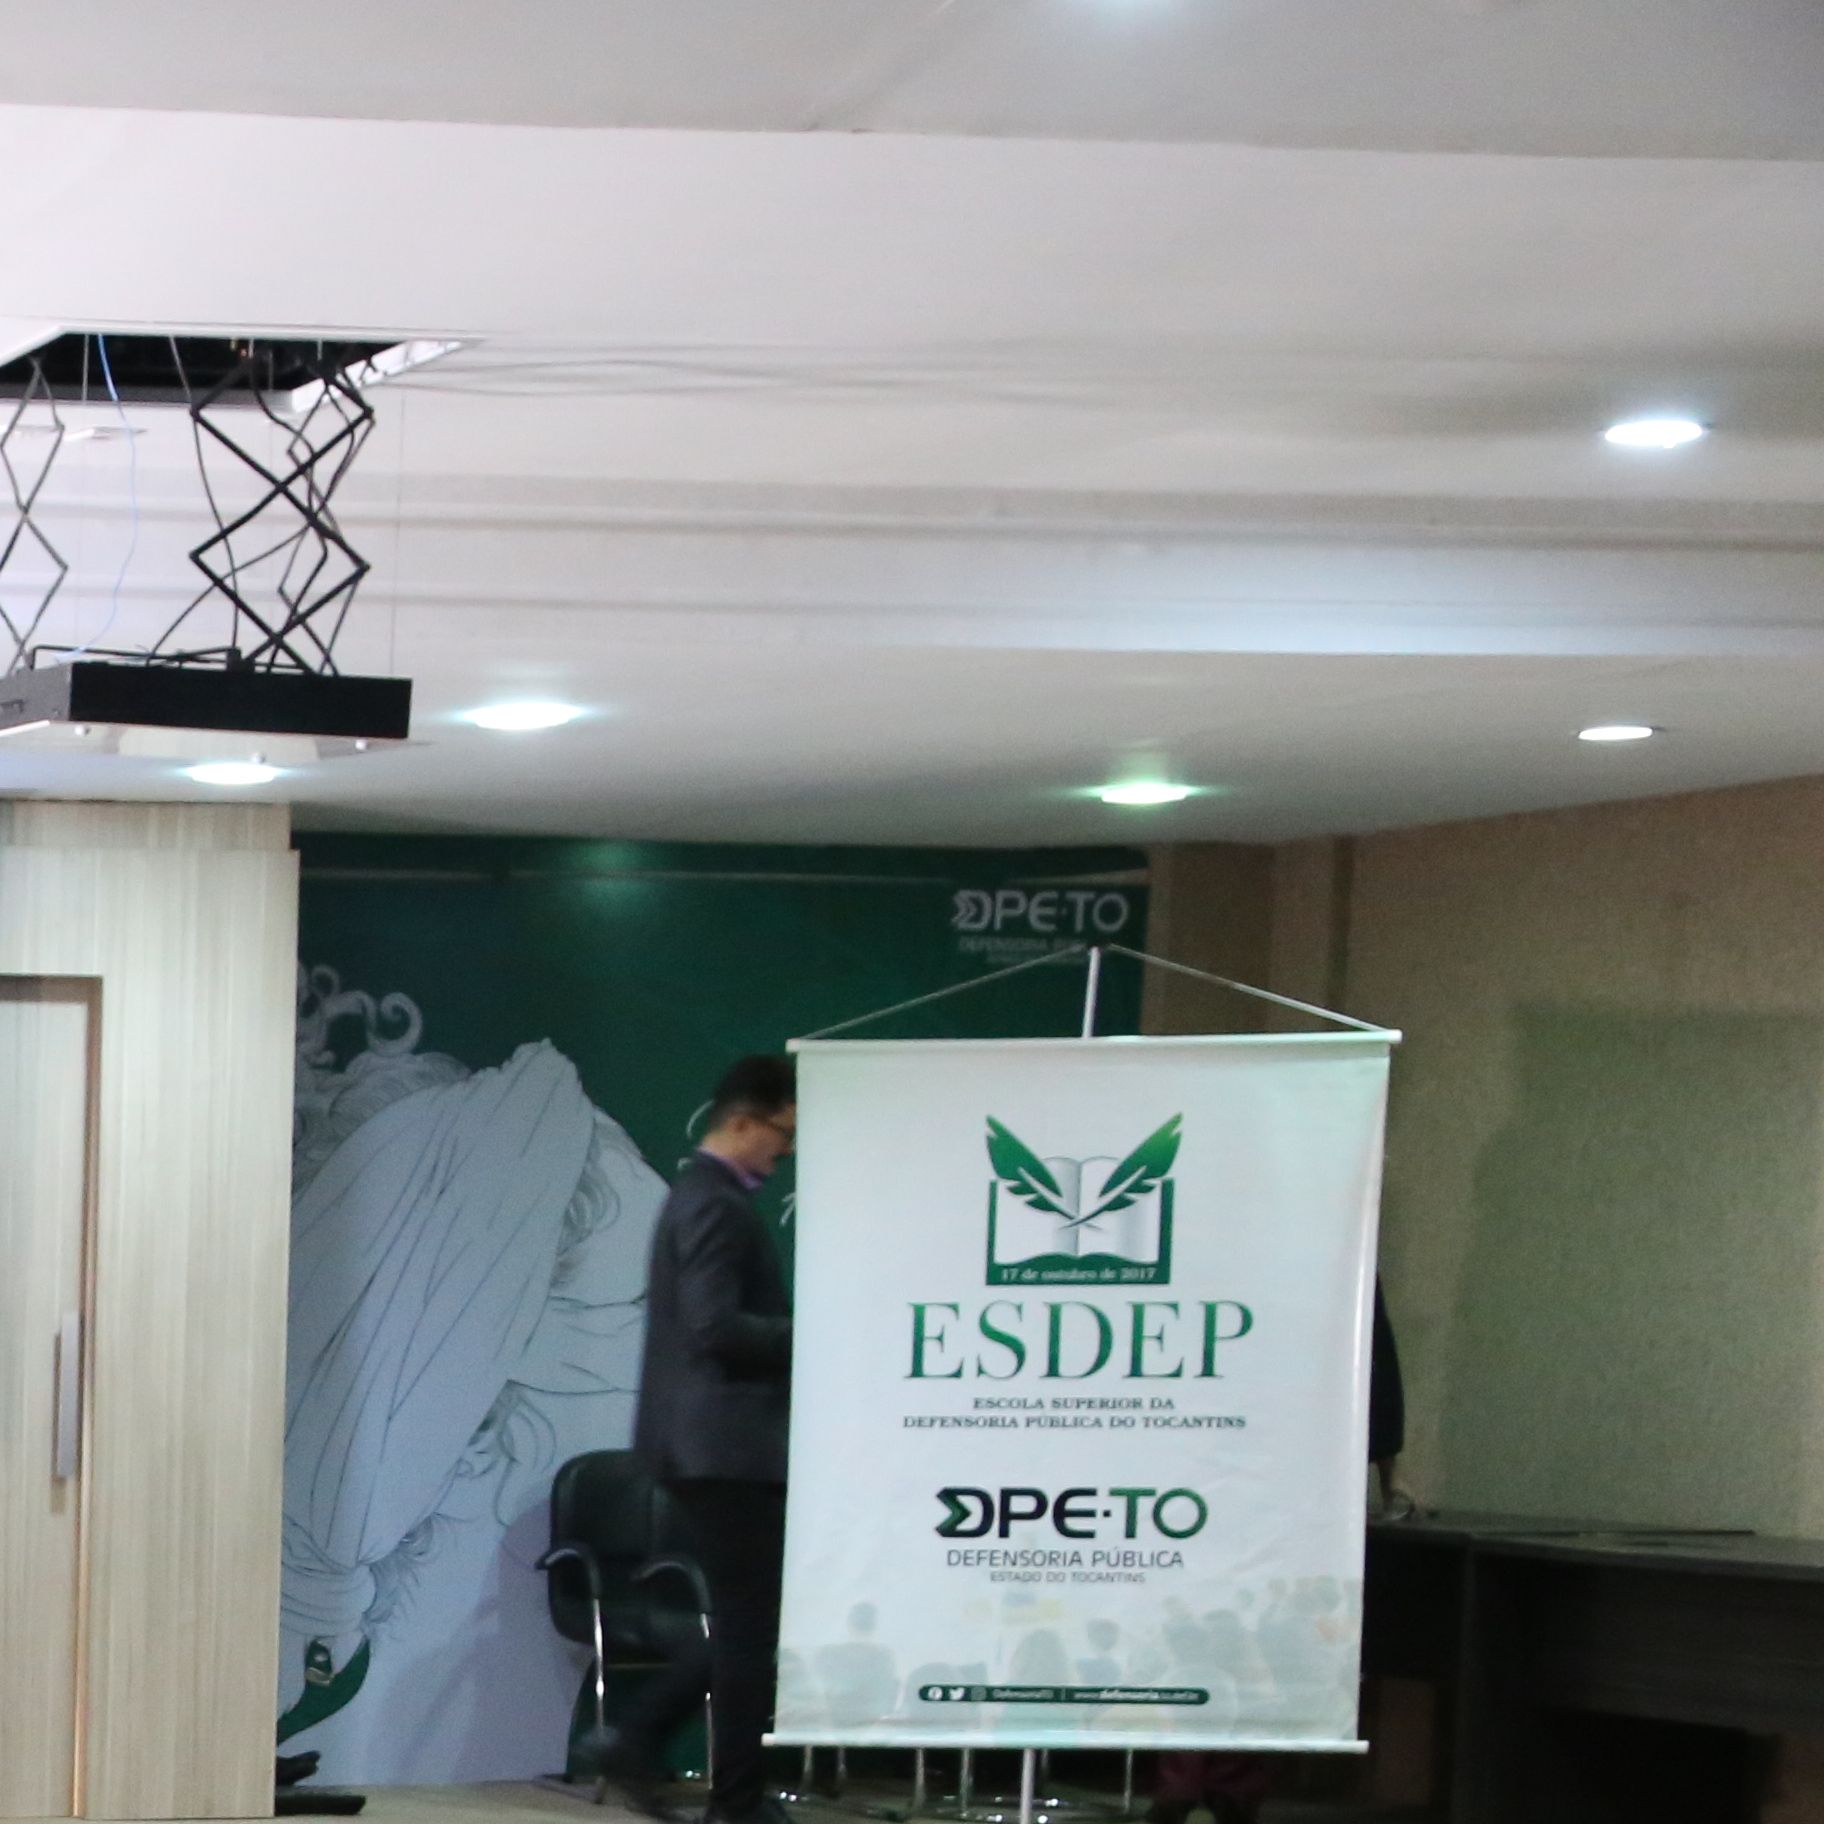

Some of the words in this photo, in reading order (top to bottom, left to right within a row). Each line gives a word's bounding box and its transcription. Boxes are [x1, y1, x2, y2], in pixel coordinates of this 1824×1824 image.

[903, 1300, 1255, 1380] ESDEP
[973, 1396, 1045, 1410] ESCOLA
[1051, 1396, 1144, 1410] SUPERIOR
[1149, 1396, 1175, 1410] DA
[902, 1415, 1020, 1429] DEFENSORIA
[1109, 1415, 1136, 1429] DO
[1142, 1415, 1247, 1429] TOCANTINS
[947, 1549, 1084, 1568] DEFENSORIA
[1092, 1546, 1184, 1568] PÚBLICA
